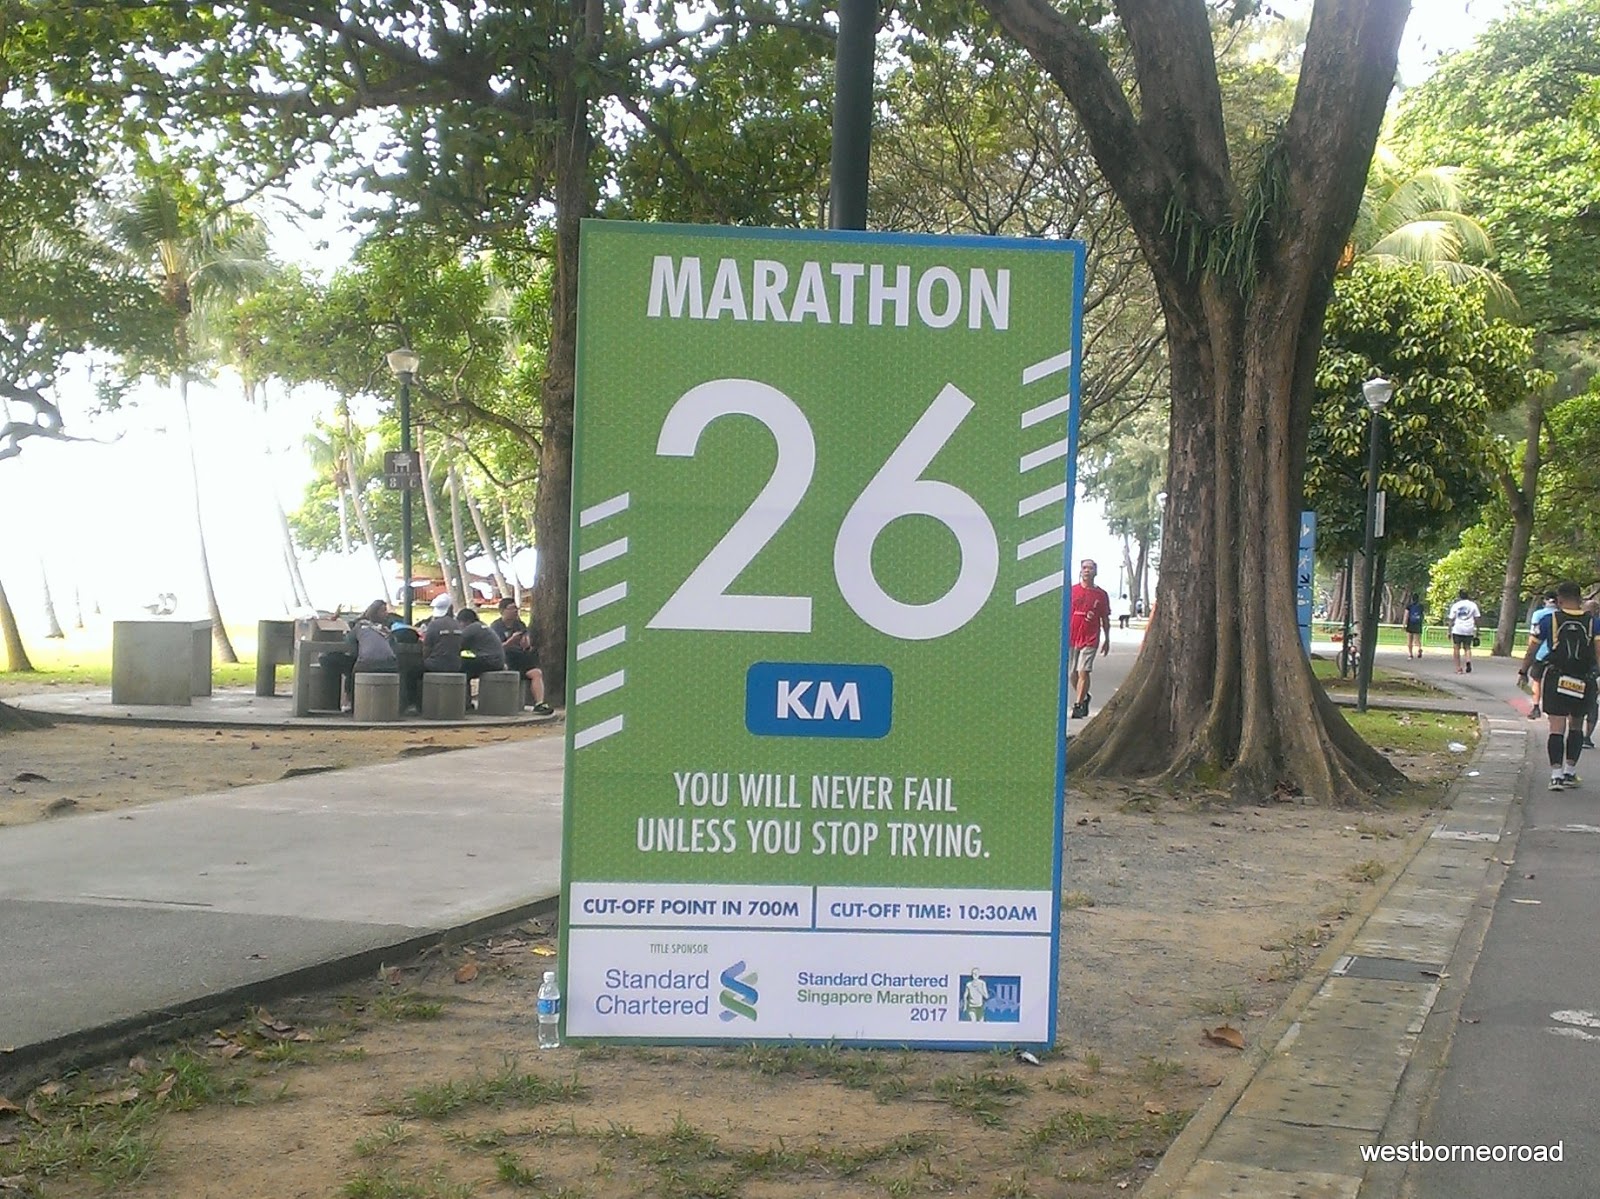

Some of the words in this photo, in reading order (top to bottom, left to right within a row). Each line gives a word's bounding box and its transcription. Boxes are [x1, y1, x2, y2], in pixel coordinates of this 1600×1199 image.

[646, 255, 1010, 331] MARATHON
[645, 378, 999, 641] 26
[775, 680, 861, 721] KM
[673, 772, 729, 807] YOU
[738, 773, 801, 809] WILL
[811, 775, 893, 811] NEVER
[903, 777, 958, 812] FAIL
[636, 818, 737, 853] UNLESS
[746, 820, 801, 854] YOU
[812, 821, 879, 856] STOP
[887, 822, 991, 858] TRYING.
[583, 898, 655, 914] CUT-OFF
[660, 900, 716, 916] POINT
[722, 900, 742, 916] IN
[748, 901, 799, 917] 700M
[830, 902, 901, 918] CUT-OFF
[906, 904, 951, 919] TIME:
[958, 904, 1037, 921] 10:30AM
[650, 943, 669, 954] TITLE
[671, 943, 708, 954] SPONSOR
[604, 968, 709, 989] Standard
[798, 972, 868, 987] Standard
[870, 973, 949, 988] Chartered
[595, 994, 709, 1015] Chartered
[797, 989, 872, 1006] Singapore
[876, 990, 948, 1005] Marathon
[910, 1008, 947, 1022] 2017
